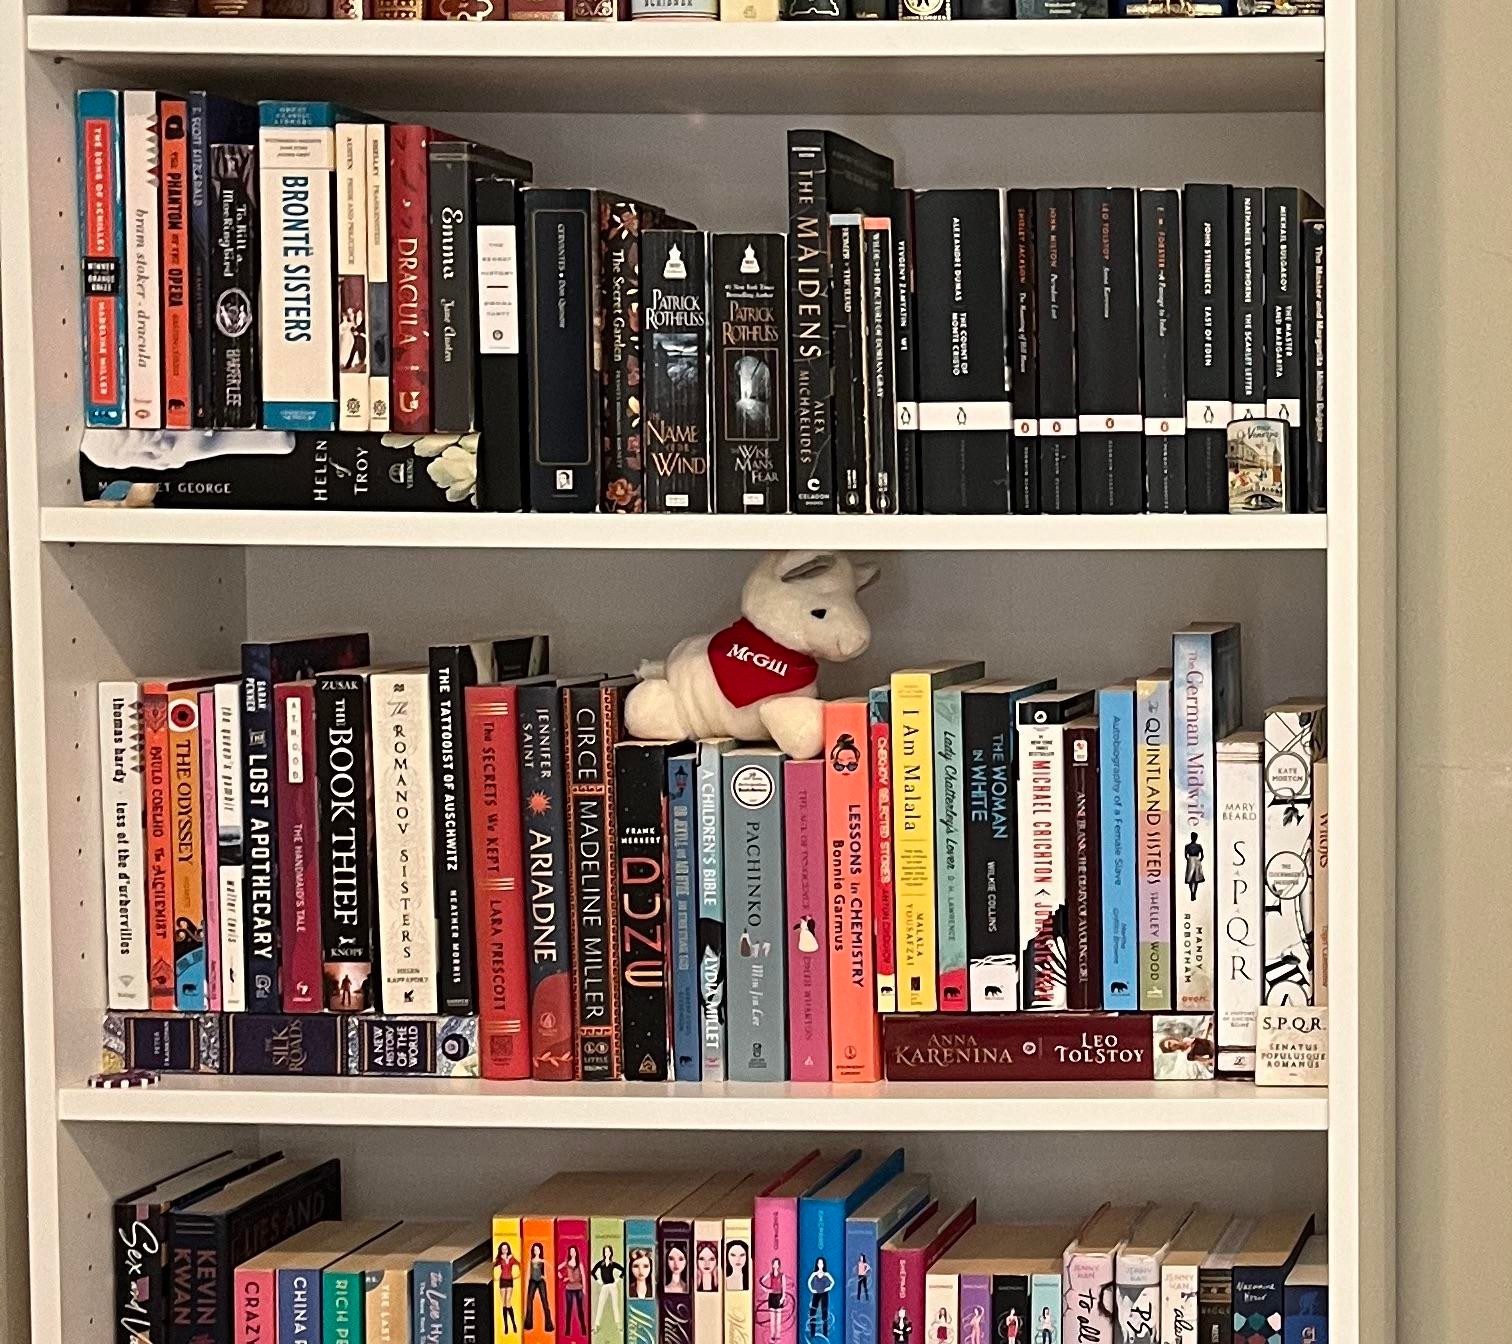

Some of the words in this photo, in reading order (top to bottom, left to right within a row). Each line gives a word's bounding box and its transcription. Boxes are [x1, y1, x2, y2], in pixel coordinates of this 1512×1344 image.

[167, 172, 183, 230] PHANTOM
[799, 171, 812, 204] THE
[281, 176, 314, 256] BRONTË
[441, 207, 463, 280] Emma
[613, 249, 625, 275] The
[798, 217, 821, 357] MAIDENS
[953, 270, 962, 300] DUMAS
[284, 263, 310, 343] SISTERS
[398, 239, 418, 346] DRACULA
[614, 277, 625, 315] Secret
[645, 307, 704, 329] ROTHFUSS
[653, 289, 700, 310] PATRICK
[614, 317, 625, 362] Garden
[800, 370, 810, 464] MICHAELIDES
[814, 400, 824, 434] ALEX
[178, 482, 232, 494] GEORGE
[314, 440, 328, 501] HELEN
[354, 447, 369, 495] TROY
[653, 452, 705, 476] WIND
[321, 680, 358, 691] ZUSAK
[727, 644, 788, 676] McGill
[178, 739, 192, 775] THE
[576, 708, 596, 780] CIRCE
[902, 724, 919, 756] Am
[249, 755, 268, 808] LOST
[330, 727, 358, 821] BOOK
[903, 764, 921, 831] Malala
[177, 779, 194, 866] ODYSSEY
[847, 804, 861, 876] LESSONS
[251, 818, 273, 959] APOTHECARY
[331, 832, 358, 927] THIEF
[579, 801, 602, 926] MADELINE
[745, 821, 761, 928] PACHINKO
[832, 840, 843, 887] Bonnie
[529, 829, 557, 964] ARIADNE
[834, 892, 844, 952] Garmus
[851, 897, 864, 988] CHEMISTRY
[584, 937, 604, 1020] MILLER
[896, 1045, 1013, 1064] KARENINA
[928, 1034, 977, 1046] ANNA
[1055, 1046, 1145, 1063] TOLSTOY
[1081, 1033, 1118, 1048] LEO
